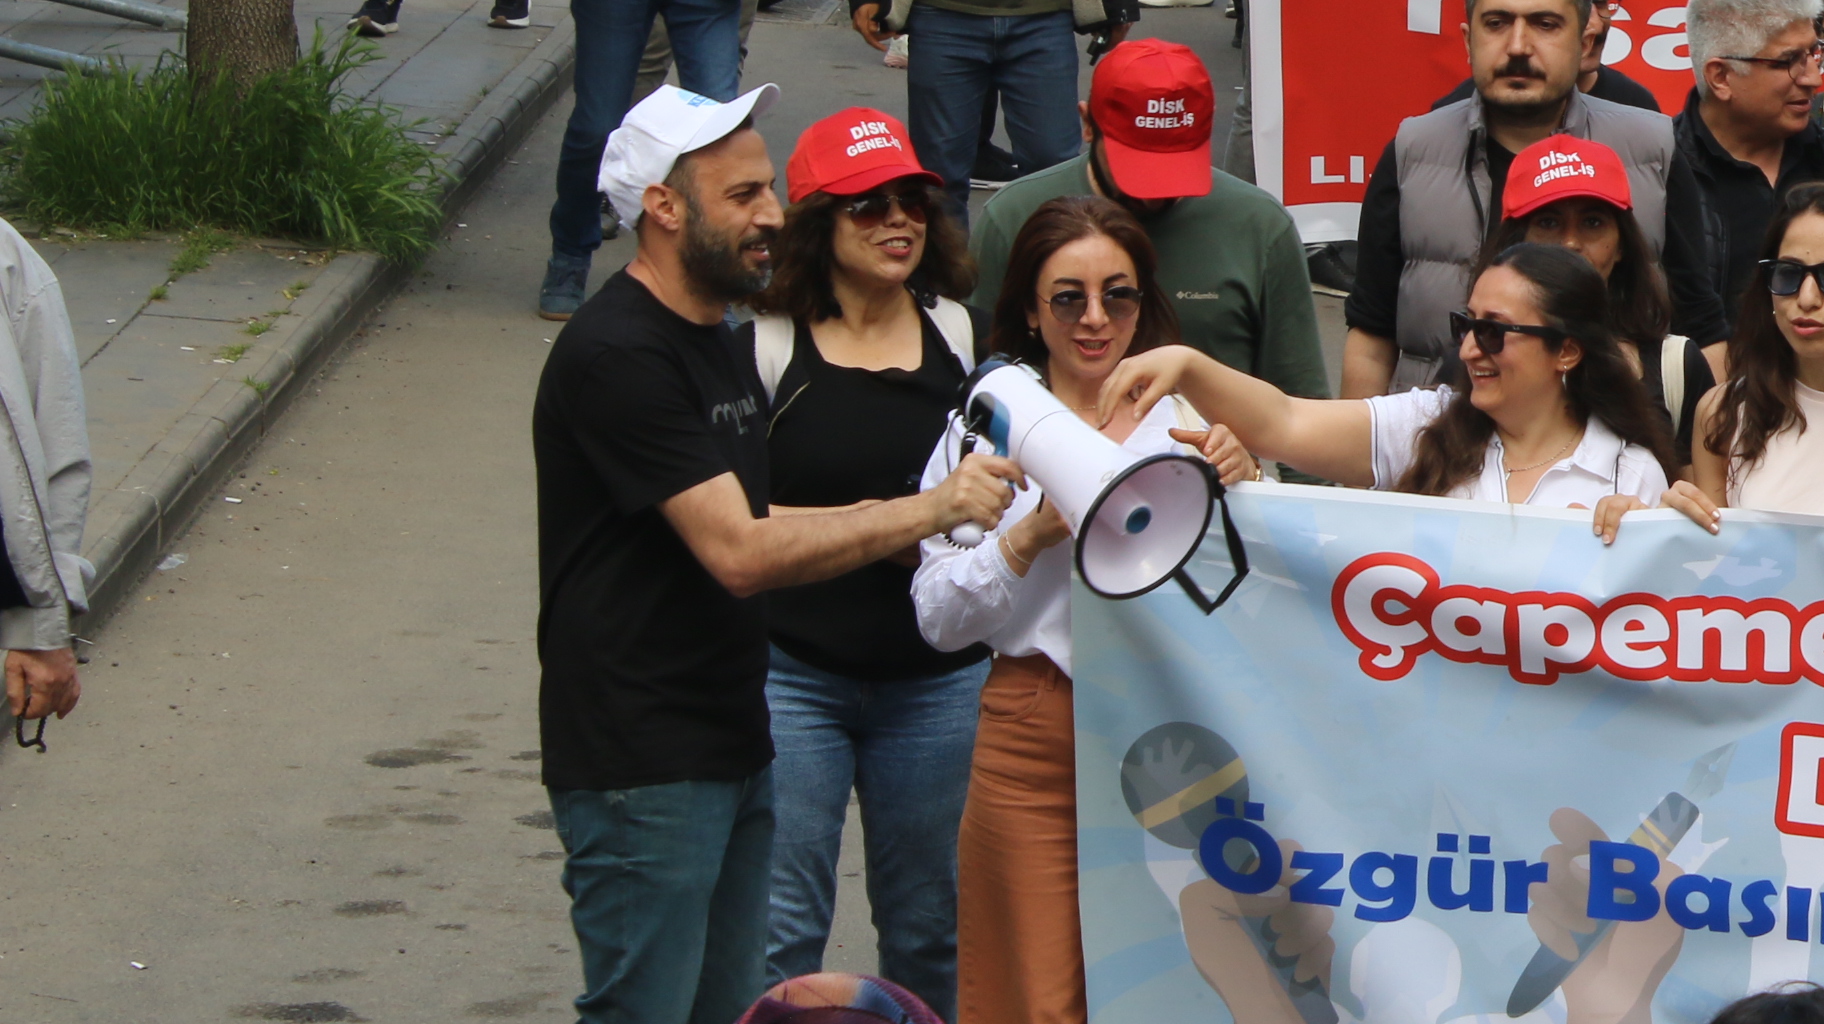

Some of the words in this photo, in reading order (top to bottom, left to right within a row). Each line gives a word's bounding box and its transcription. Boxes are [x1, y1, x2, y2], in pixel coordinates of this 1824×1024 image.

[1146, 97, 1185, 114] DİSK
[848, 119, 889, 142] DİSK
[1134, 111, 1195, 129] GENEL-İŞ
[1539, 150, 1581, 171] DİSK
[1533, 162, 1595, 188] GENEL-İŞ
[1201, 797, 1549, 923] Özgür
